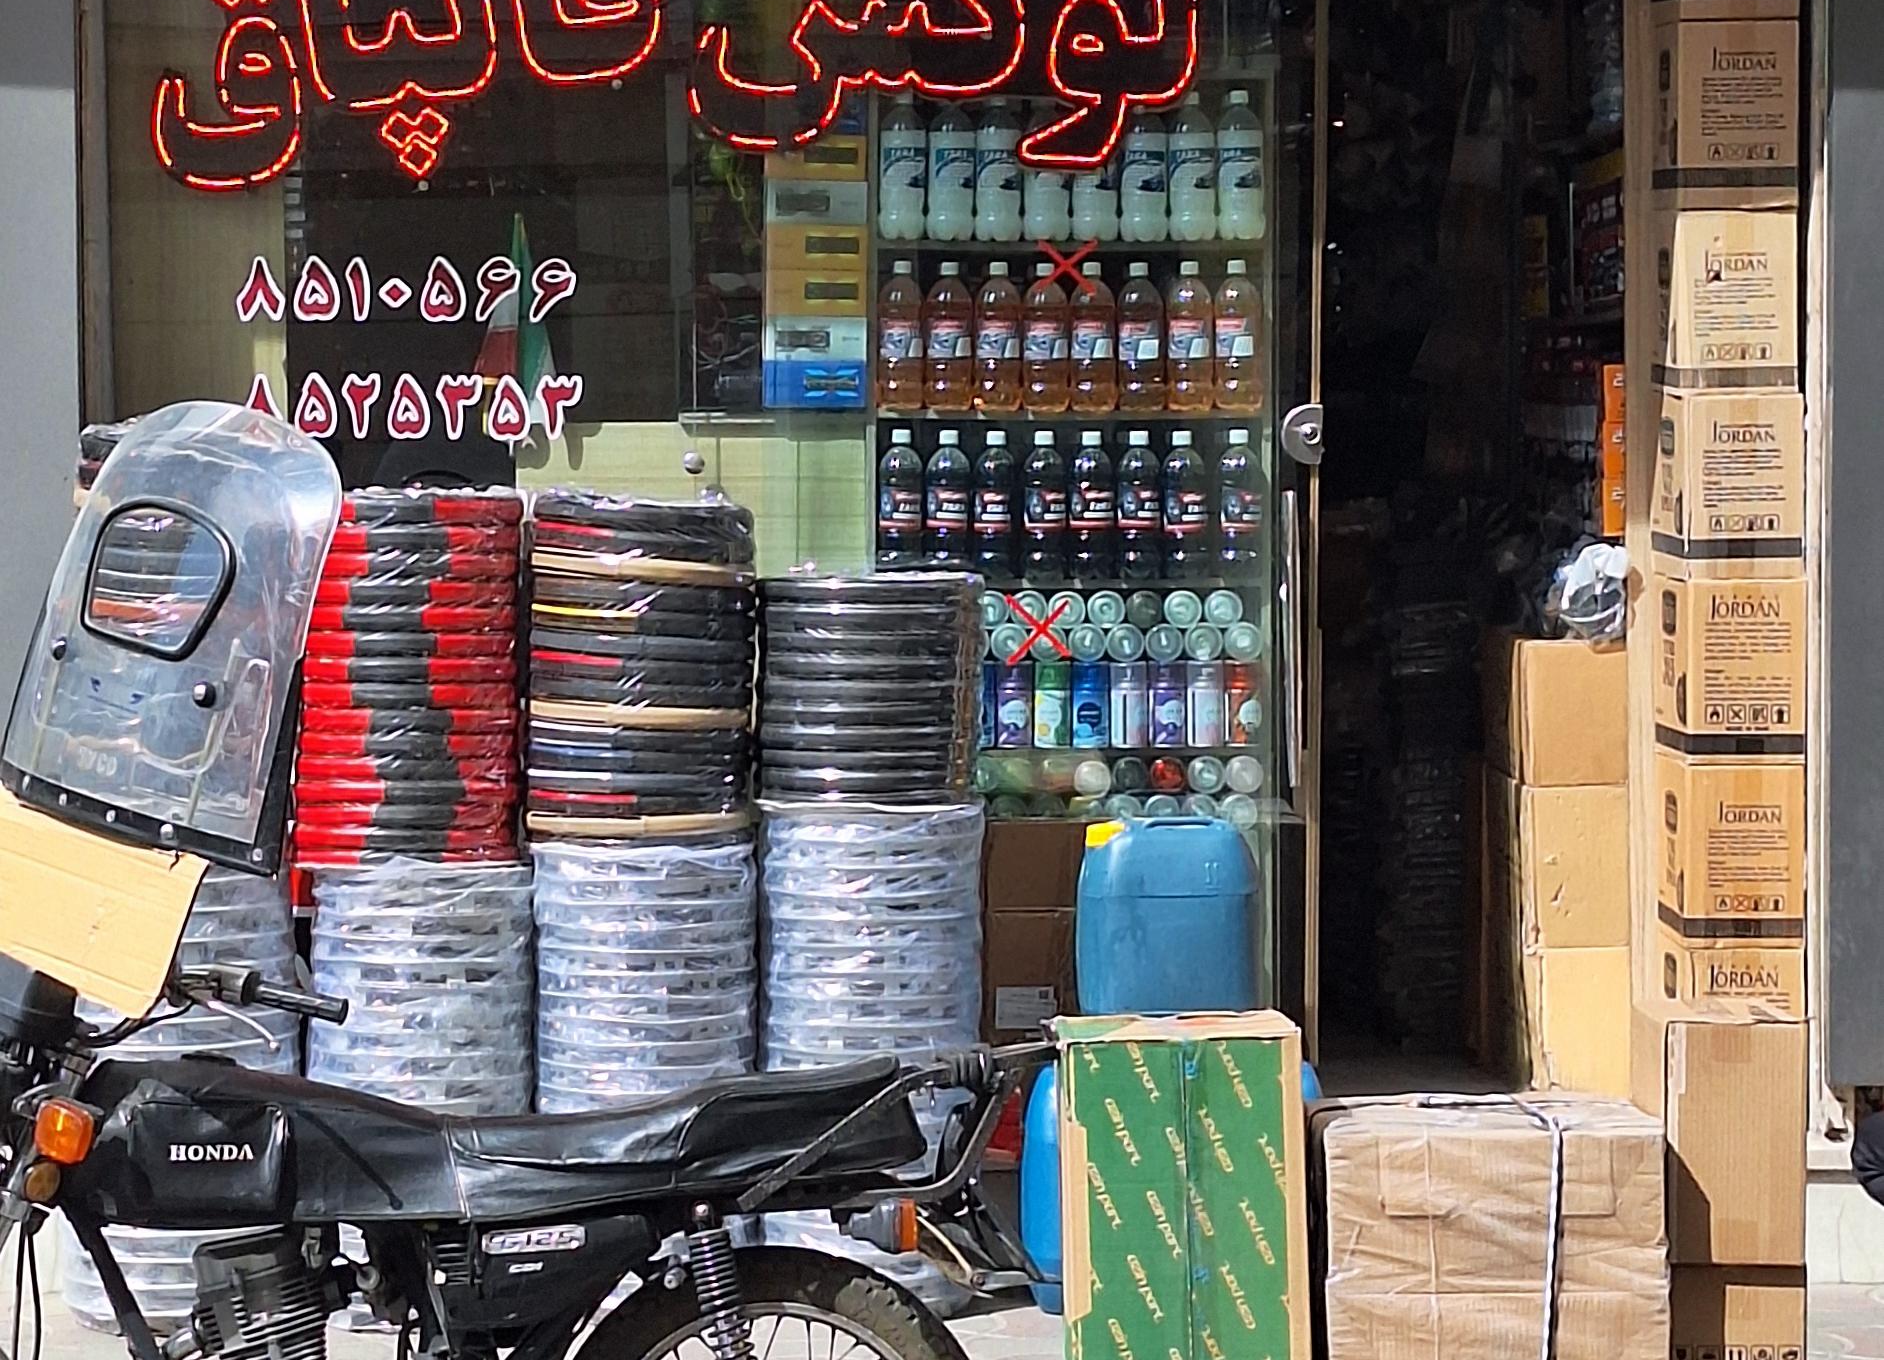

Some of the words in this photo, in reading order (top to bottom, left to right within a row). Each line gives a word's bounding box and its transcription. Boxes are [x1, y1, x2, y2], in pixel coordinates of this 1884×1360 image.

[1711, 46, 1777, 71] JORDAN
[236, 255, 578, 322] ۸۵۱۰۵۶۶
[1712, 420, 1776, 443] JORDAN
[1711, 593, 1781, 621] JORDAN
[1718, 800, 1782, 824] JORDAN
[1709, 963, 1779, 990] JORDAN
[169, 1143, 254, 1161] HONDA
